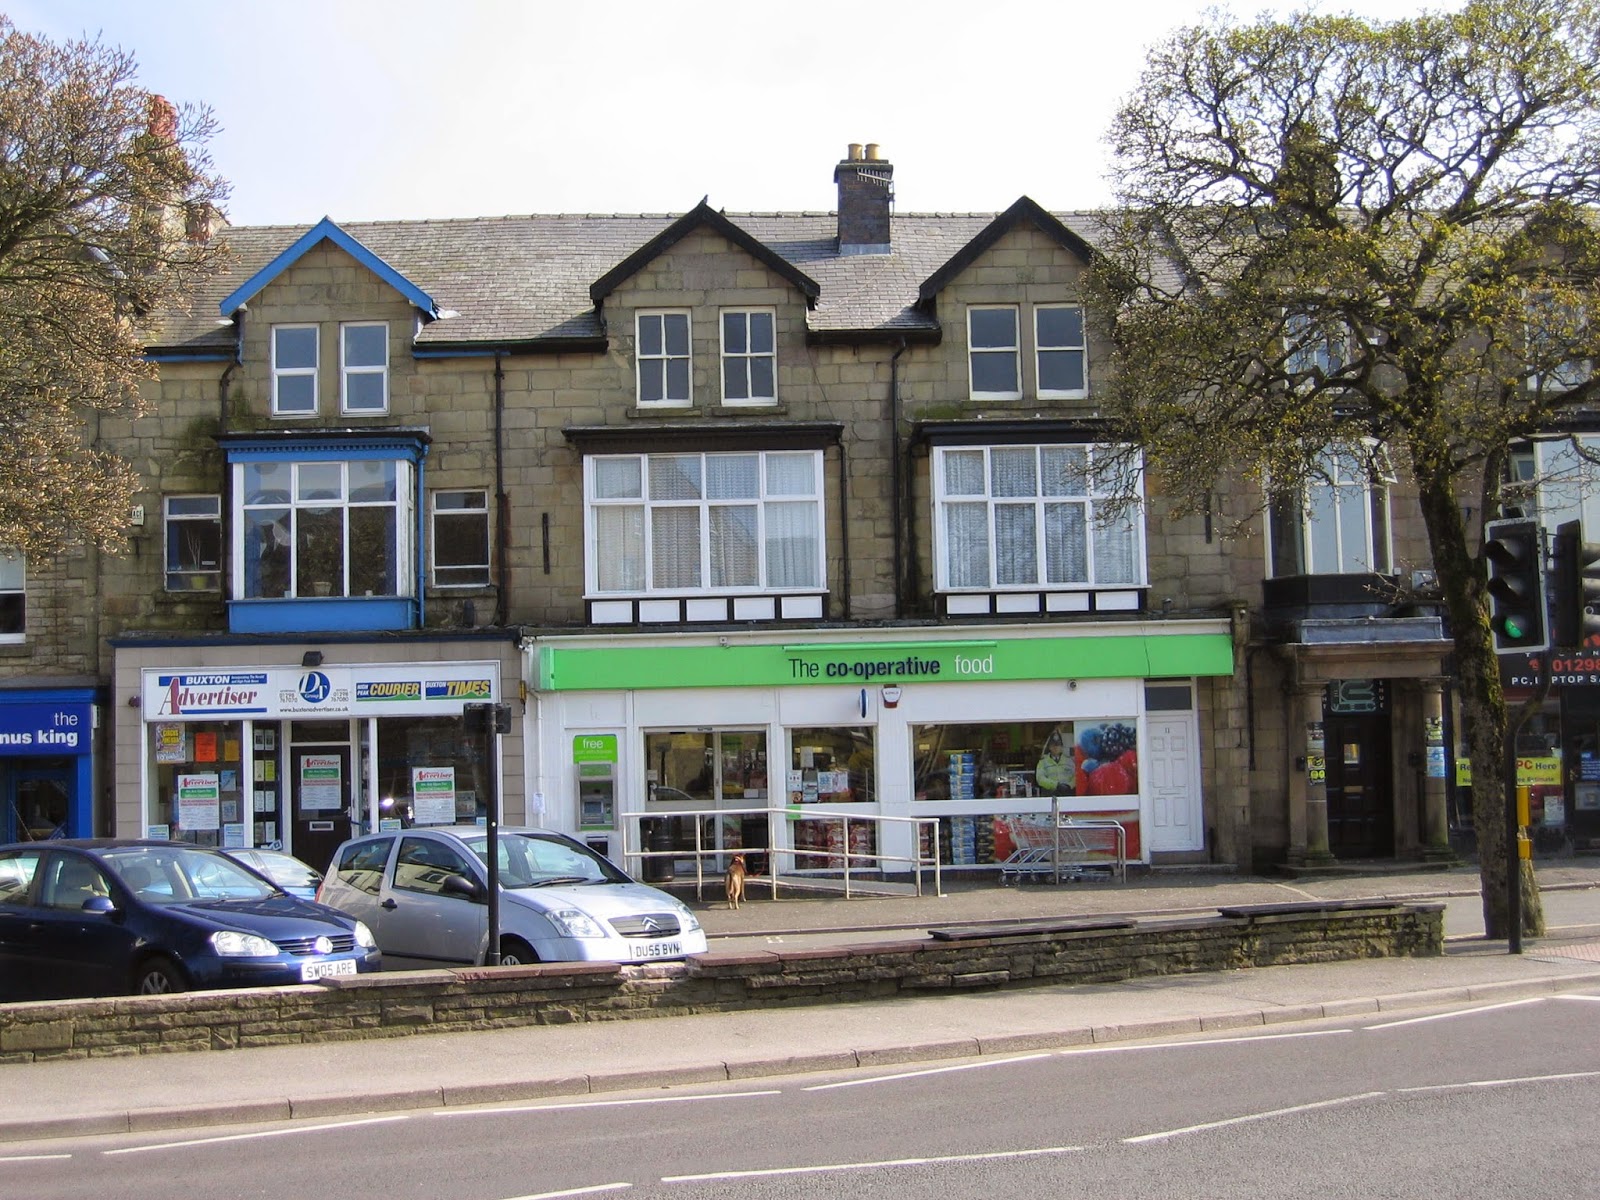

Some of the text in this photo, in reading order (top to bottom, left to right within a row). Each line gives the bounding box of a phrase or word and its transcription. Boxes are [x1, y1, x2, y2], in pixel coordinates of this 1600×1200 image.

[788, 658, 819, 678] The
[954, 654, 994, 674] food
[186, 675, 230, 685] BUXTON
[369, 682, 420, 696] COURIER
[447, 680, 490, 696] TIMES
[157, 677, 258, 715] Advertiser
[54, 711, 78, 726] the
[38, 729, 78, 747] king
[583, 738, 604, 749] free
[303, 758, 340, 768] Advertiser
[1516, 760, 1533, 769] PC
[180, 778, 218, 788] Advertiser
[415, 771, 453, 781] Advertiser
[636, 942, 680, 957] DU55 BVN
[306, 962, 353, 978] SW05 ARE
